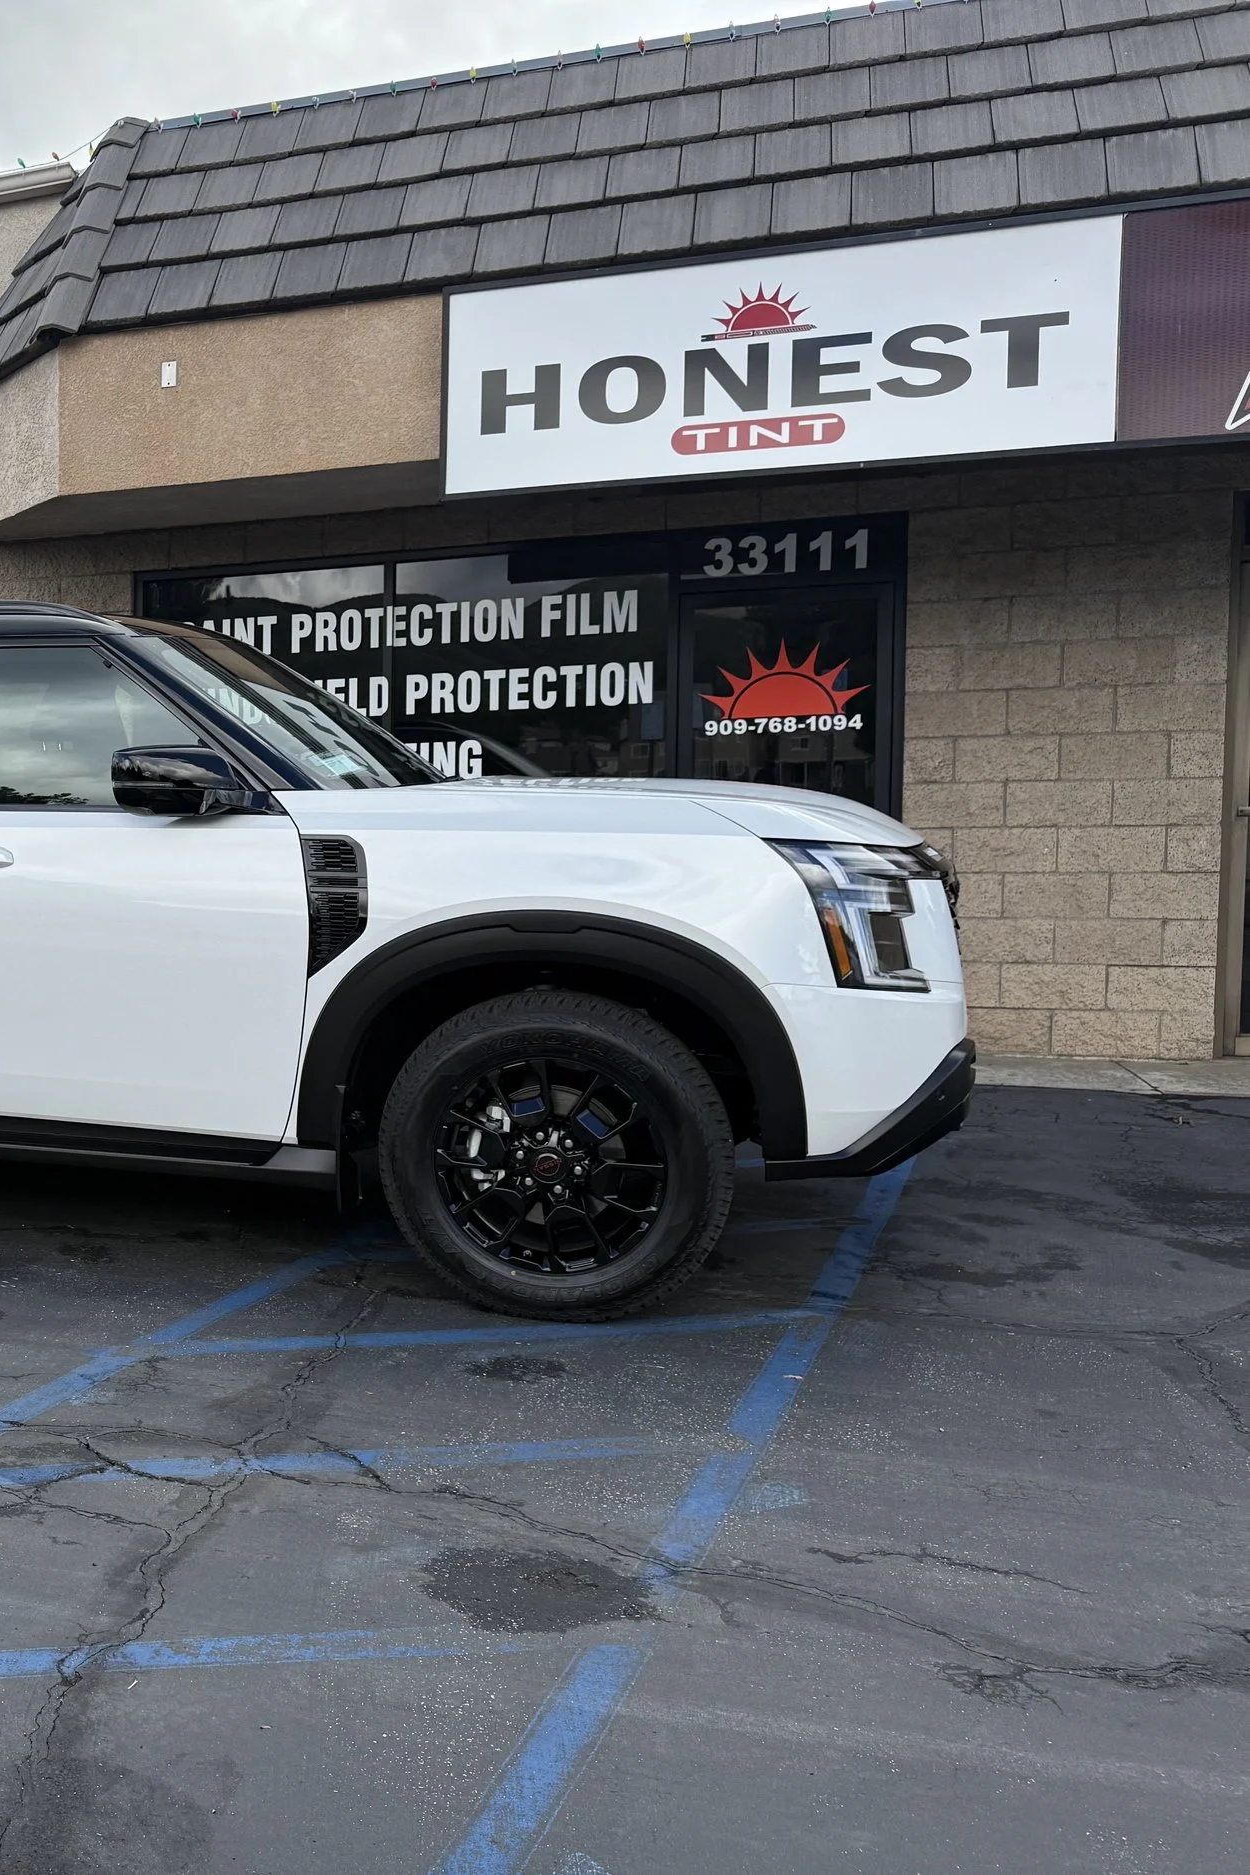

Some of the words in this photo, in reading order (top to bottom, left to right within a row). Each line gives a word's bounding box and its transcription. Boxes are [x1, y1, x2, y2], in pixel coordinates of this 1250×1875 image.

[481, 310, 1070, 436] HONEST
[682, 417, 840, 451] TINT
[702, 528, 869, 578] 33111
[290, 597, 525, 654] PROTECTION
[540, 590, 638, 637] FILM
[406, 662, 654, 715] PROTECTION
[704, 713, 863, 736] 909-768-1094
